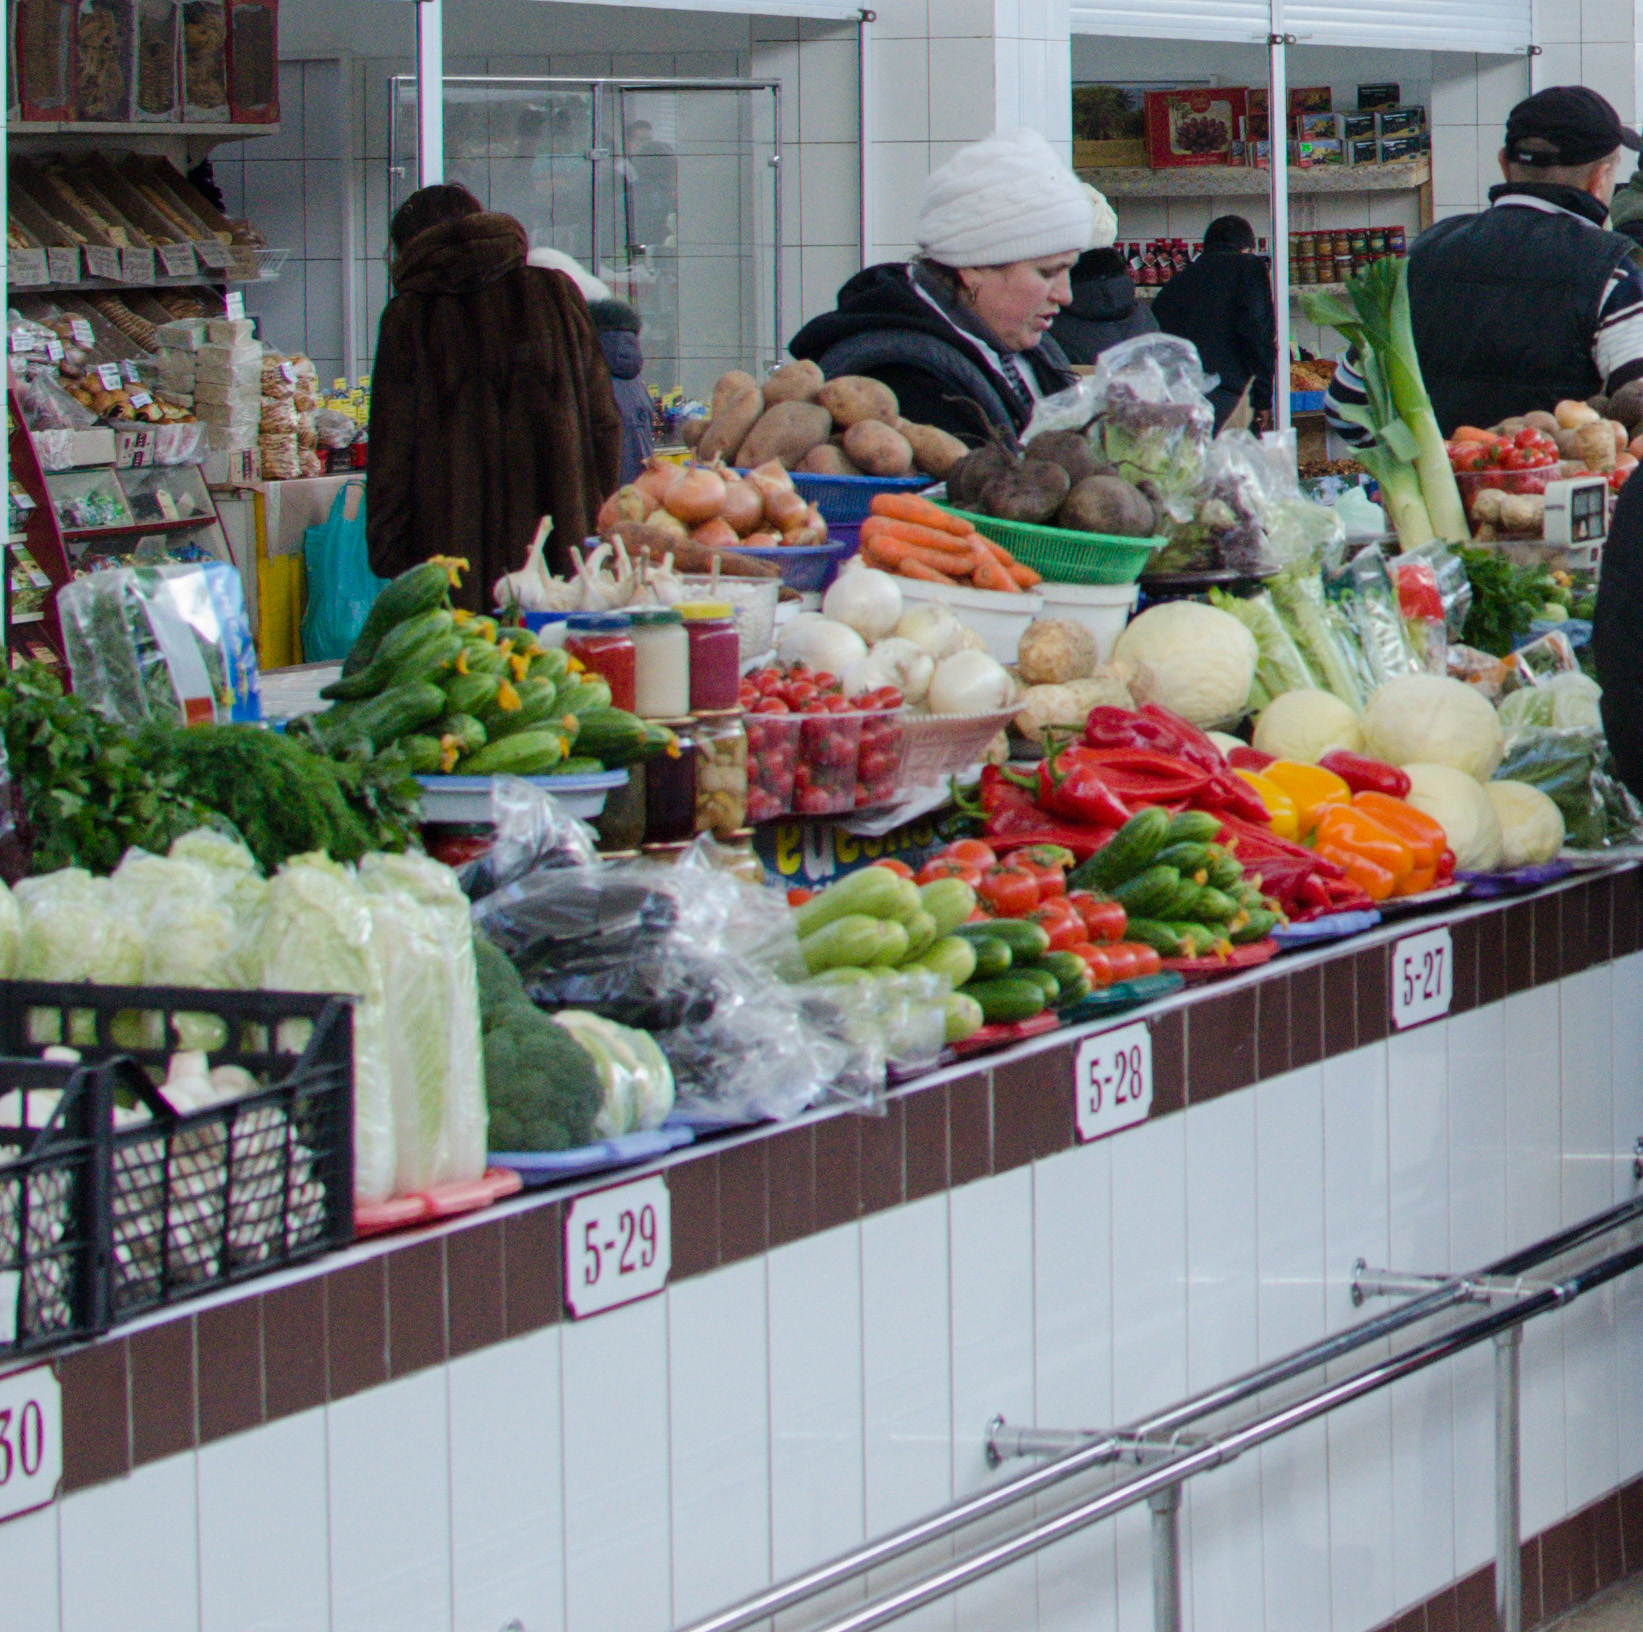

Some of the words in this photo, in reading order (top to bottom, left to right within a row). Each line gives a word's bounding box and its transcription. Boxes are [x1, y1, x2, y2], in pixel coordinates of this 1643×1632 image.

[1403, 947, 1444, 1007] 5-27
[1089, 1044, 1143, 1114] 5-28
[584, 1203, 657, 1286] 5-29
